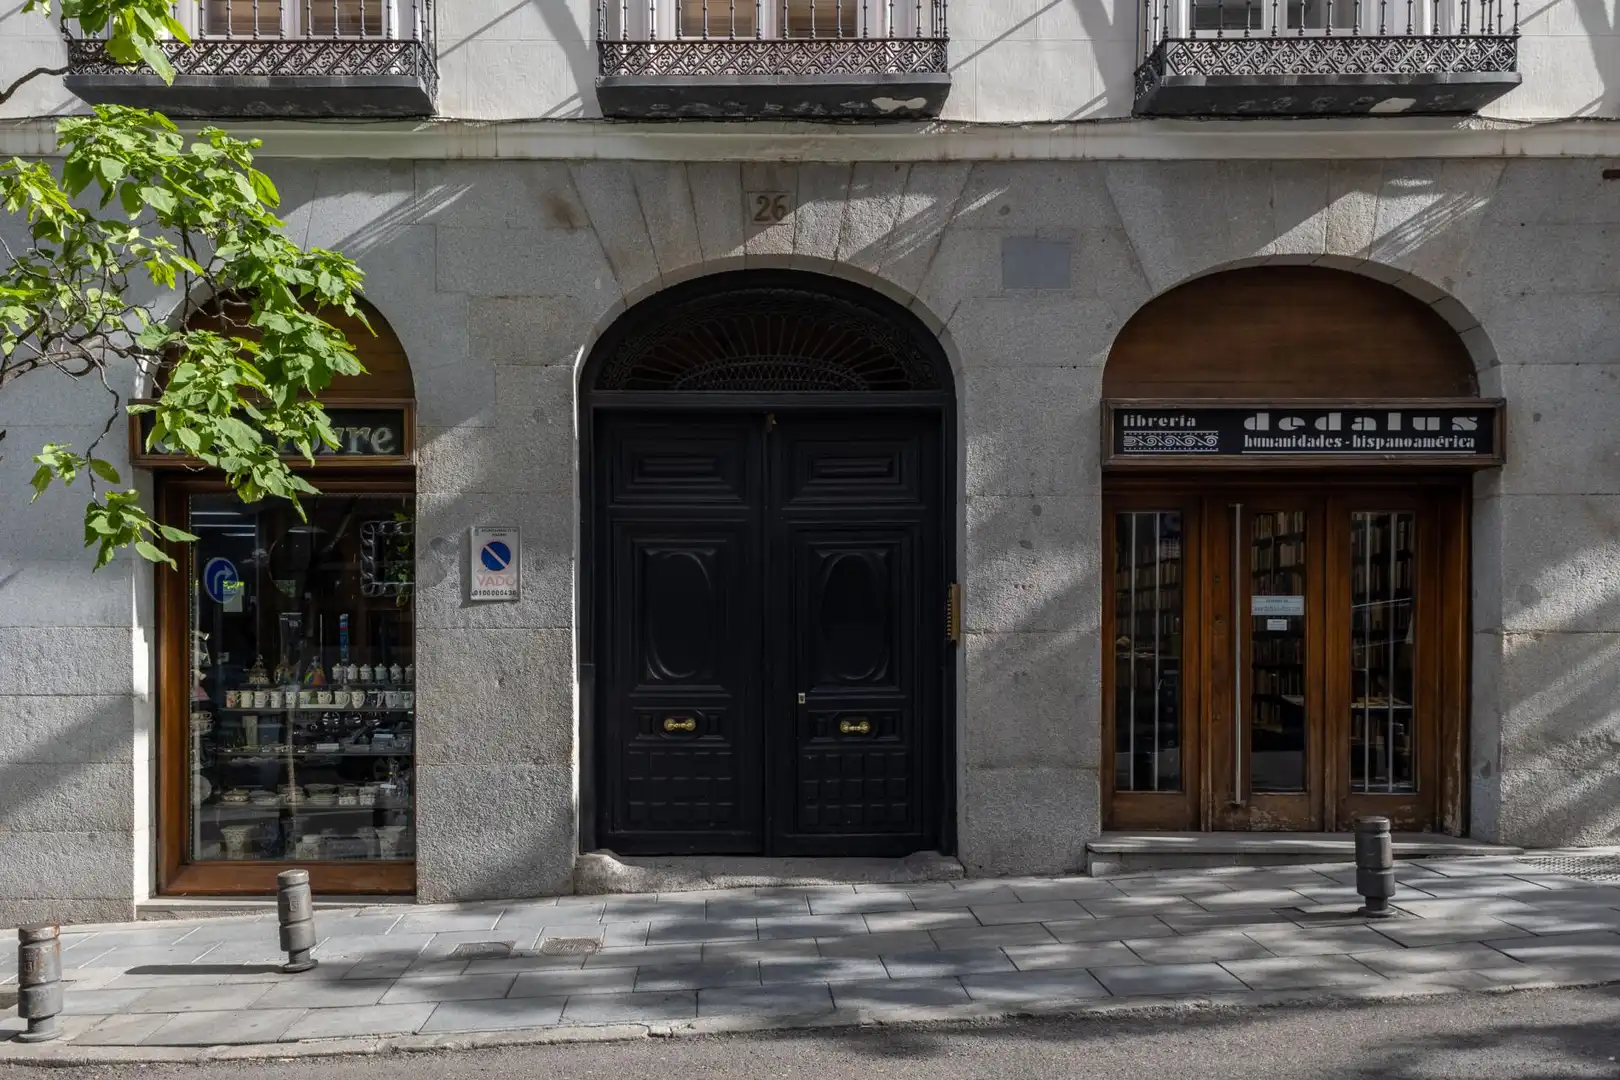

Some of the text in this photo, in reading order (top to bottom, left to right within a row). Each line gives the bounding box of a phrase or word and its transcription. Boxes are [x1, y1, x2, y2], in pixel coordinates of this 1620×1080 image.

[753, 195, 787, 221] 26
[1243, 412, 1478, 431] dedalus
[476, 575, 516, 588] VADO
